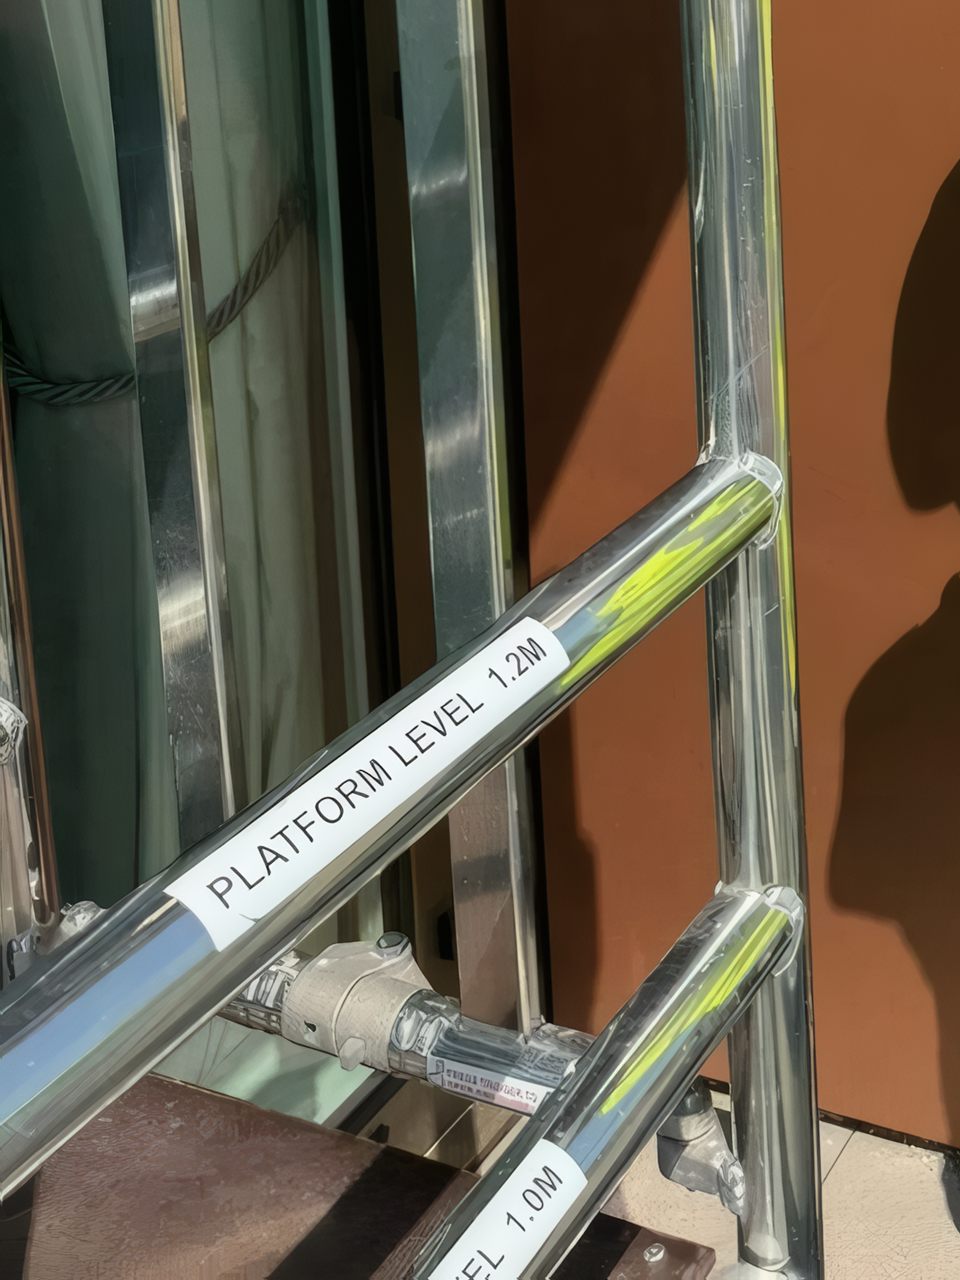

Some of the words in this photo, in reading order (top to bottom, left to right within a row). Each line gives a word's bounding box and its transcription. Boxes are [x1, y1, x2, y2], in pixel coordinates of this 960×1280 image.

[206, 758, 392, 909] PLATFORM
[388, 693, 484, 767] LEVEL
[488, 637, 547, 688] 1.2M
[506, 1165, 563, 1232] 1.0M
